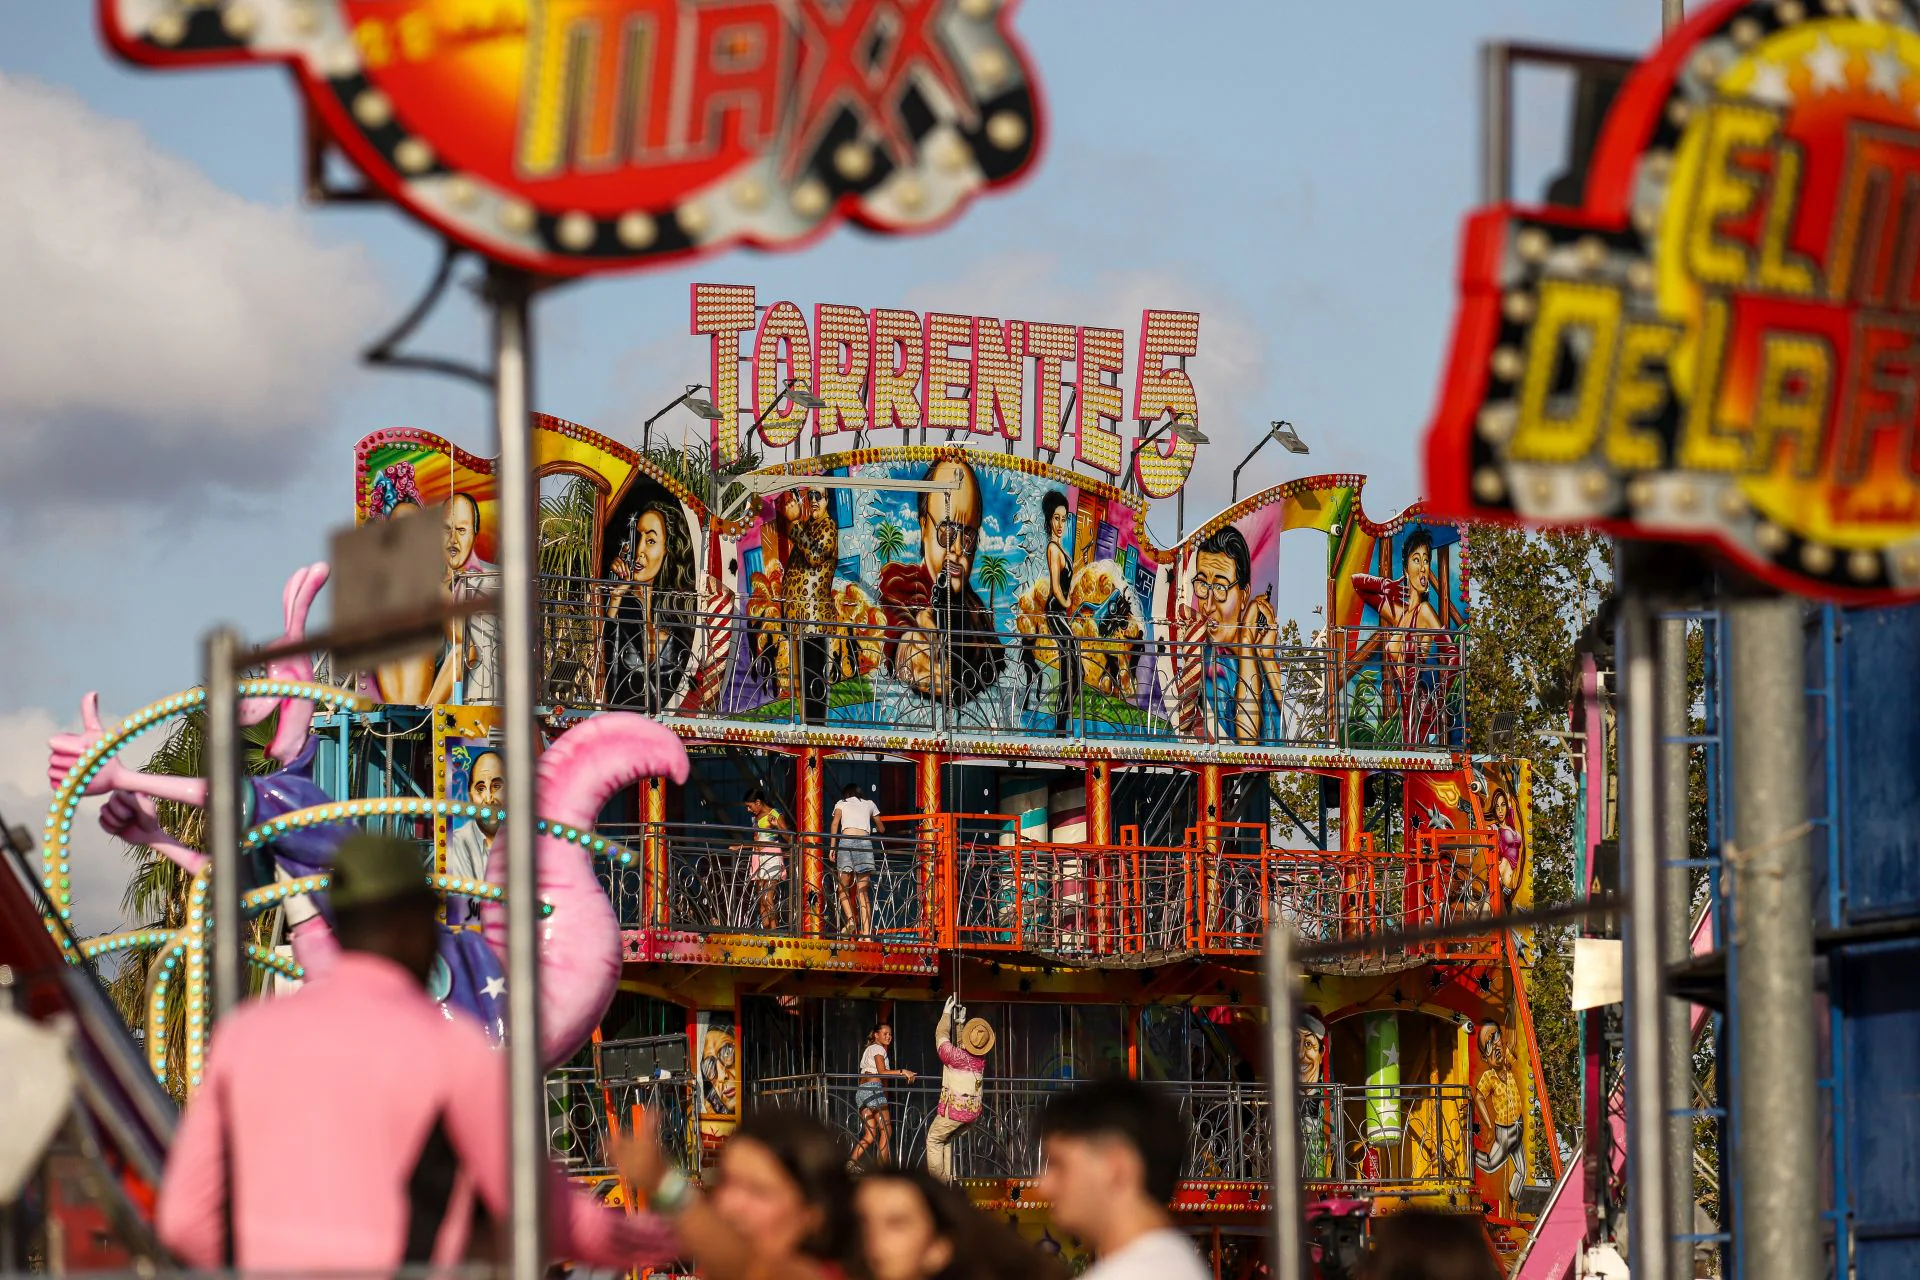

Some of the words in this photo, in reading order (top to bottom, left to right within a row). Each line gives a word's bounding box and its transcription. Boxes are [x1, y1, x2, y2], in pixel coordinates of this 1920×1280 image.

[514, 0, 980, 182] MAXX
[1686, 104, 1818, 293] EL
[1826, 120, 1920, 306] M
[689, 283, 1124, 477] TORRENTE
[1132, 309, 1201, 499] 5
[1836, 312, 1920, 484] F
